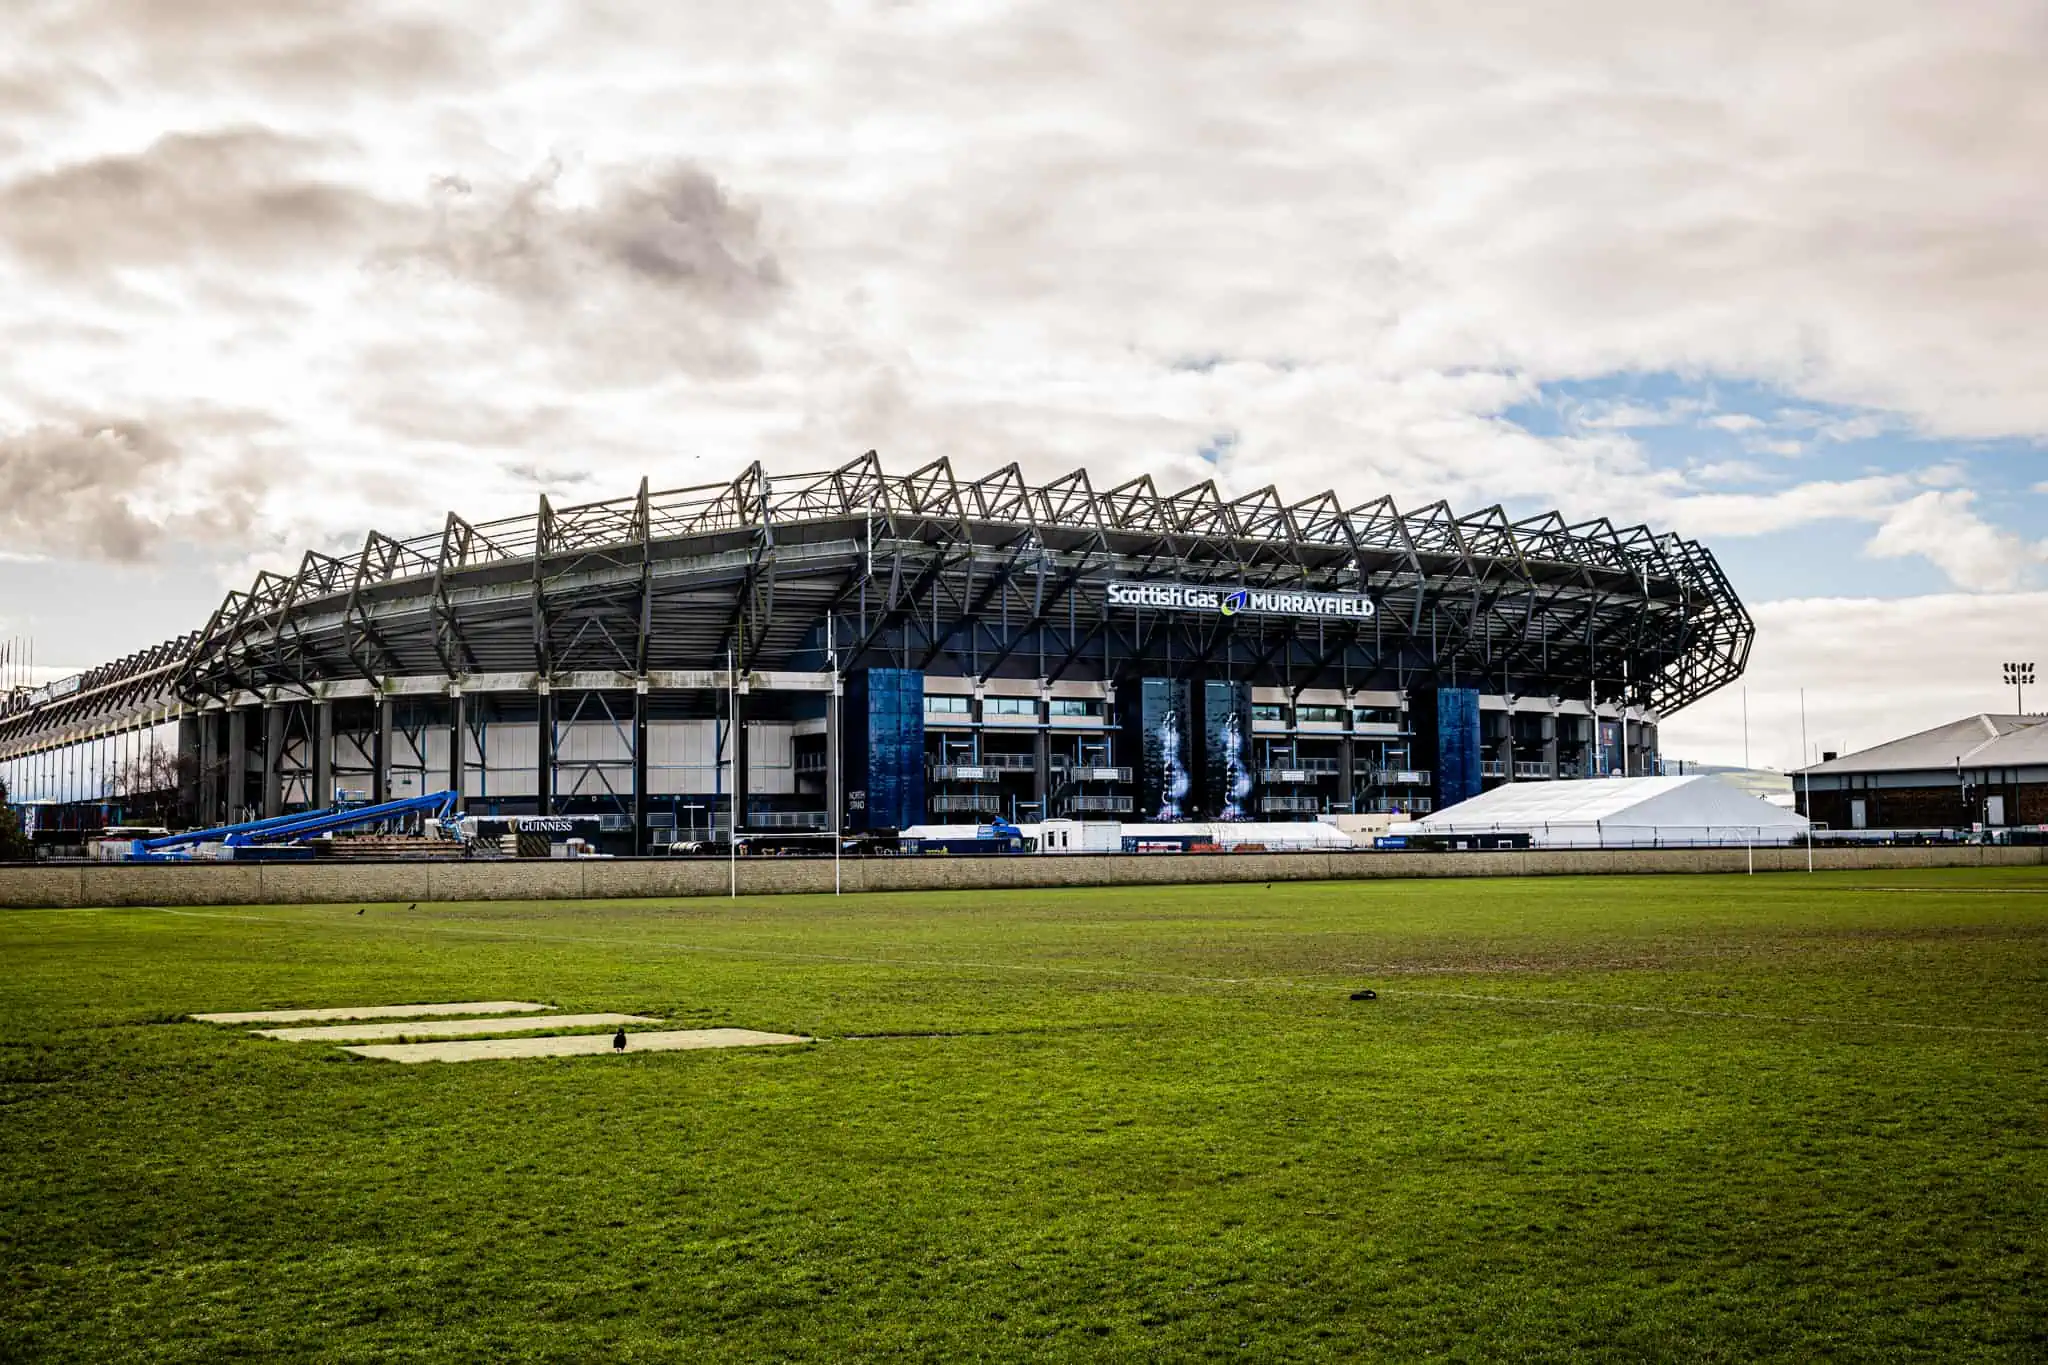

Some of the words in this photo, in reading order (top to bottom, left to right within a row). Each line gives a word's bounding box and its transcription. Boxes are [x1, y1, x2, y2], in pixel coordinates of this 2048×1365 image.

[1107, 584, 1182, 606] Scottish
[1184, 588, 1218, 608] Gas
[1251, 594, 1375, 617] MURRAYFIELD
[519, 820, 573, 832] GUINNESS
